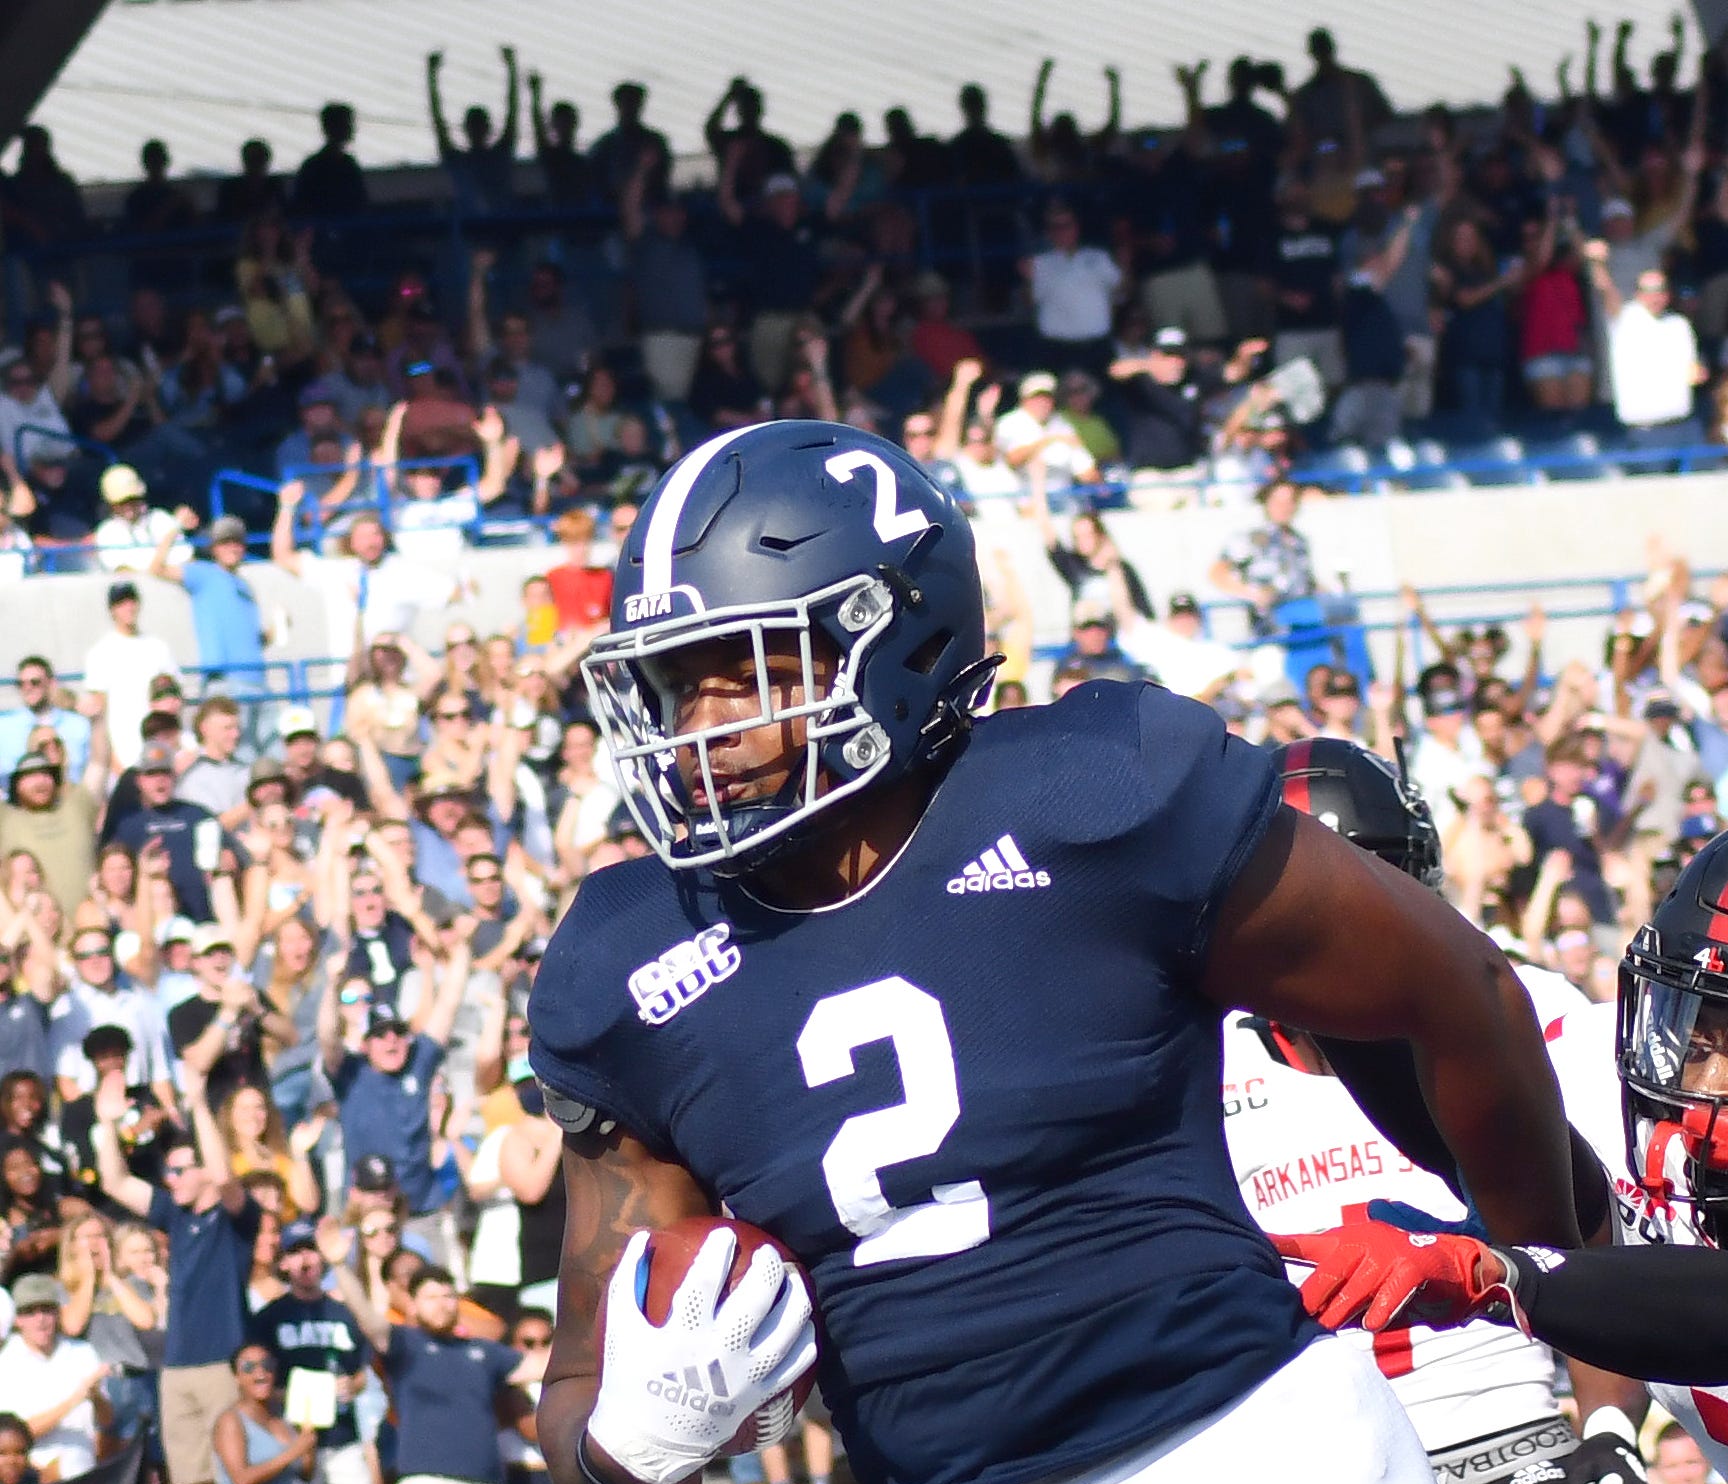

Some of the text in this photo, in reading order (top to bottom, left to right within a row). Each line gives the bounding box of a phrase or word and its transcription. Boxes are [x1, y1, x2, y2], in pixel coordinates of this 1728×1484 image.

[825, 449, 930, 544] 2
[625, 593, 673, 623] GATA
[946, 868, 1052, 895] adidas
[796, 976, 991, 1268] 2
[1222, 1078, 1269, 1118] BC
[1252, 1140, 1384, 1212] ARKANSAS
